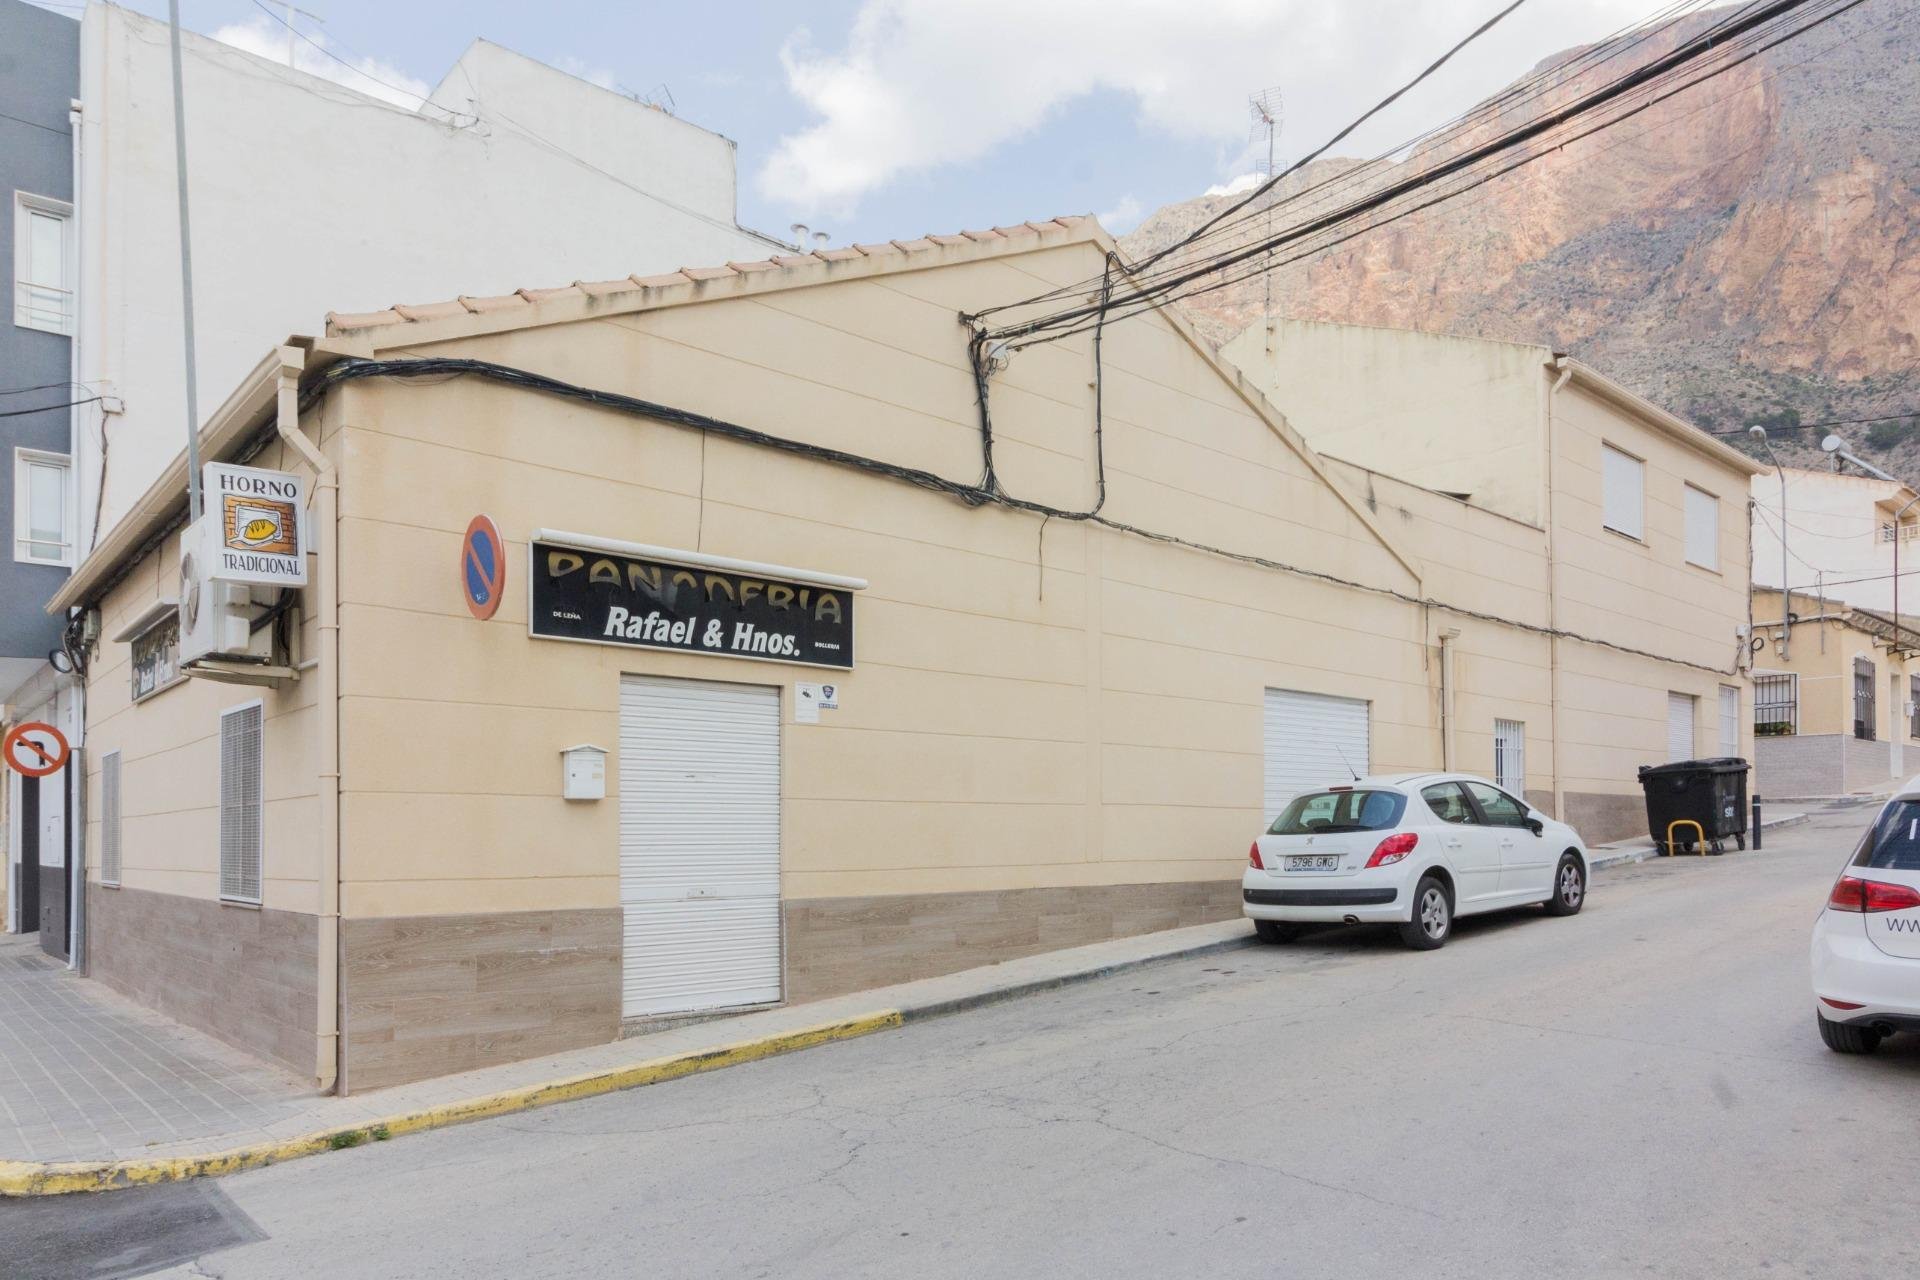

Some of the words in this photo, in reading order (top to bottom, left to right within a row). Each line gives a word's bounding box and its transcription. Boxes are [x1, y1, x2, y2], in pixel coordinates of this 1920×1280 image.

[220, 474, 297, 498] HORNO
[223, 553, 301, 576] TRADICIONAL
[603, 606, 697, 645] Rafael
[702, 618, 724, 648] &
[730, 622, 801, 657] Hnos.
[1292, 857, 1313, 868] 5796
[1316, 857, 1334, 867] GWG
